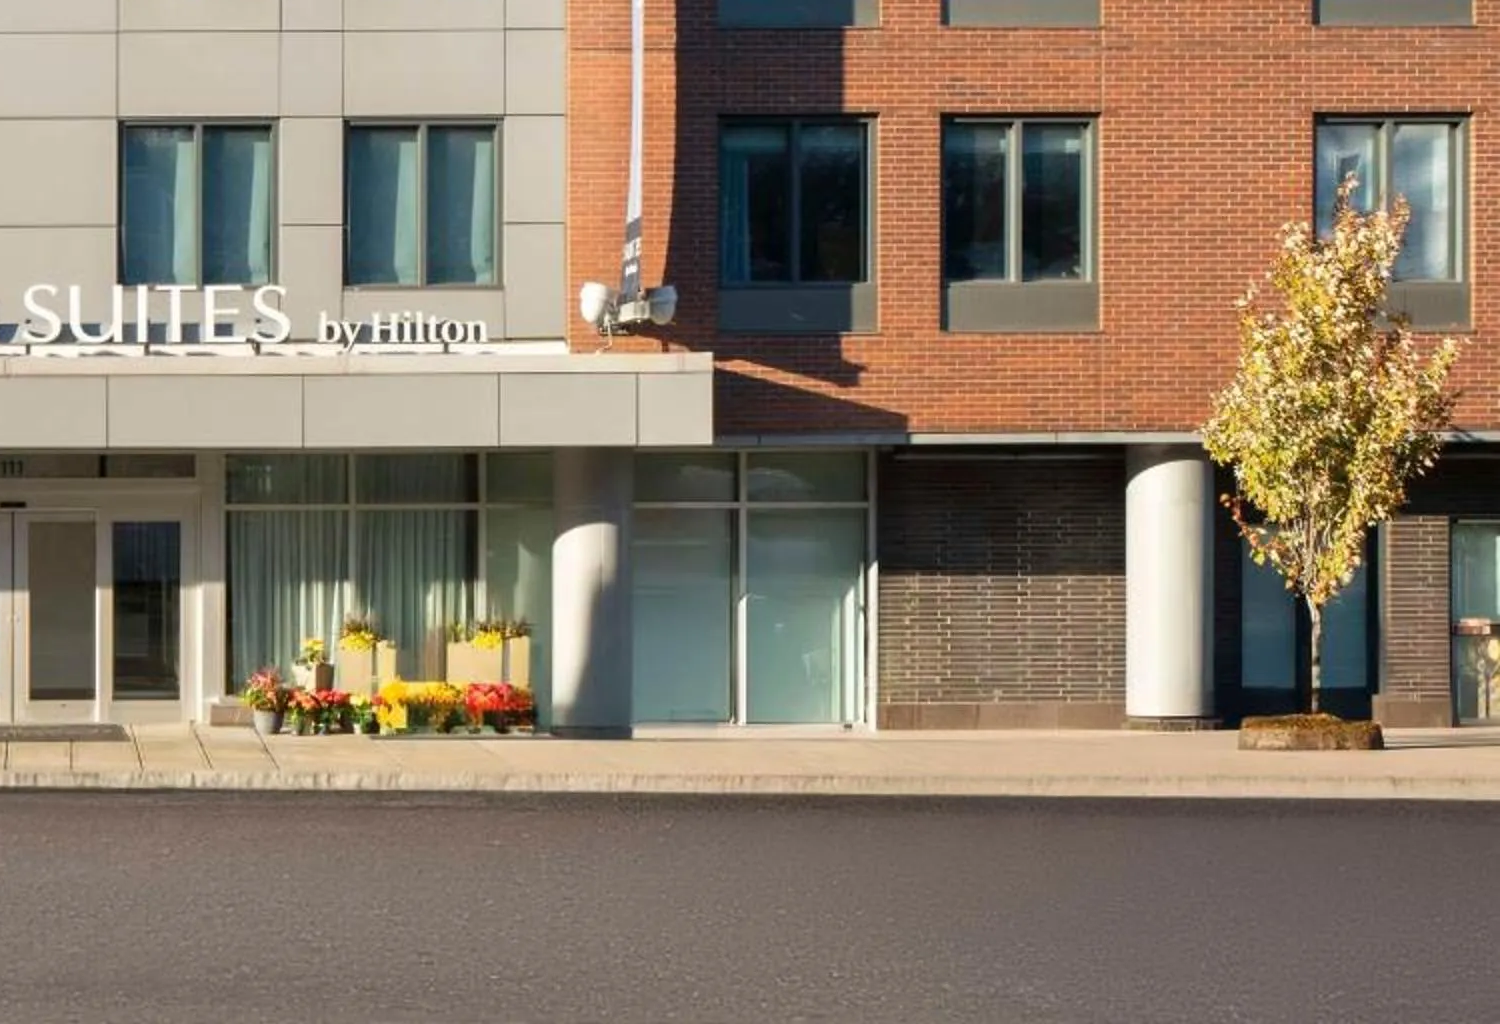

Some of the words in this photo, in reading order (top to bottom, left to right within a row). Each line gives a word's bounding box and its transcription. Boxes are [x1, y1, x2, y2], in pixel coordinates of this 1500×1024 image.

[23, 284, 291, 344] SUITES
[318, 310, 361, 352] by
[371, 311, 489, 344] Hilton
[0, 460, 24, 475] 111
